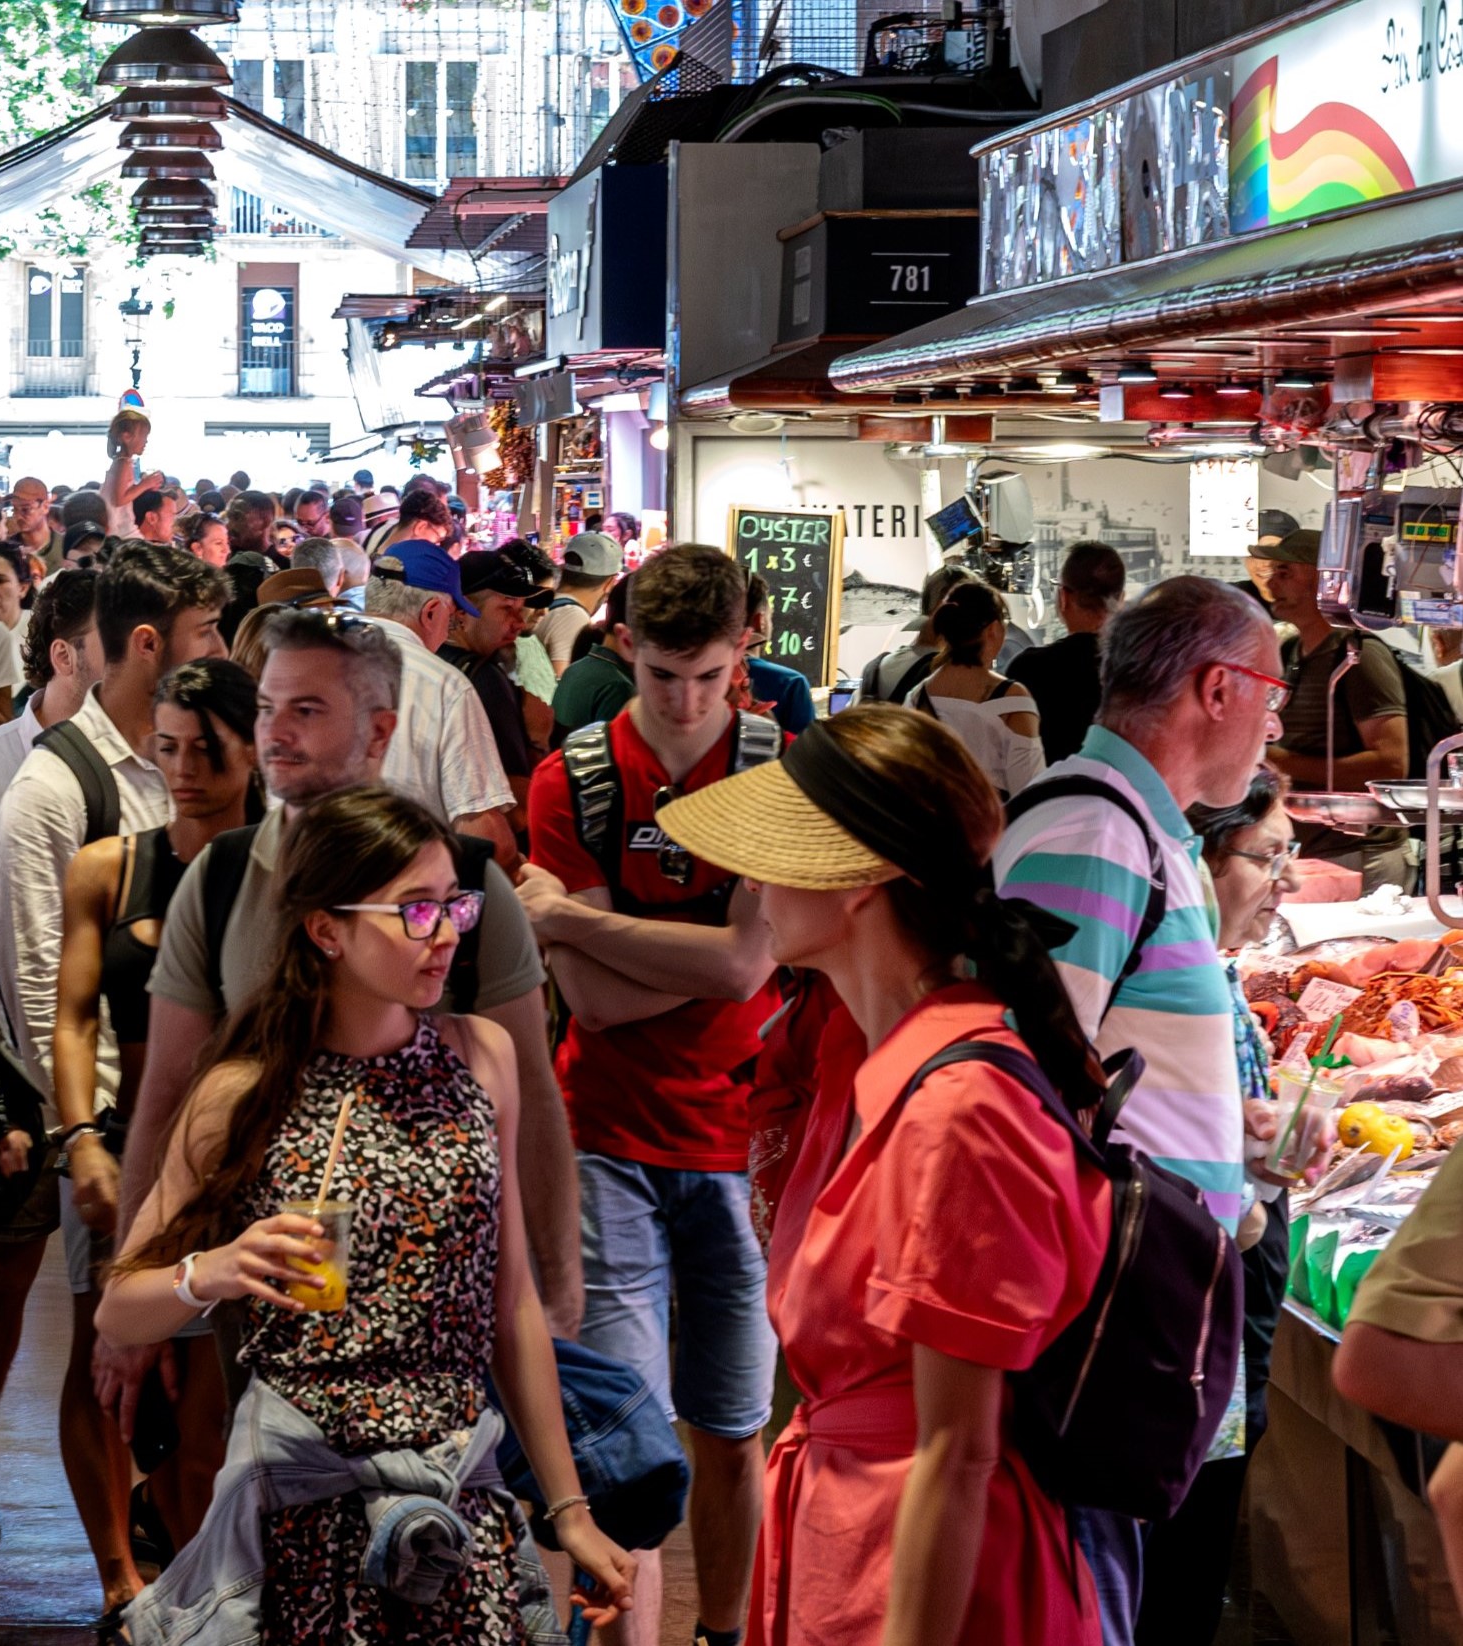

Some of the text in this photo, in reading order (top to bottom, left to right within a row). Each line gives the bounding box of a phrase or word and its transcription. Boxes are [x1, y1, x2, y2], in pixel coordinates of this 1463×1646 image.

[890, 266, 930, 291] 781
[250, 322, 285, 333] TACO
[739, 515, 830, 545] OYSTER
